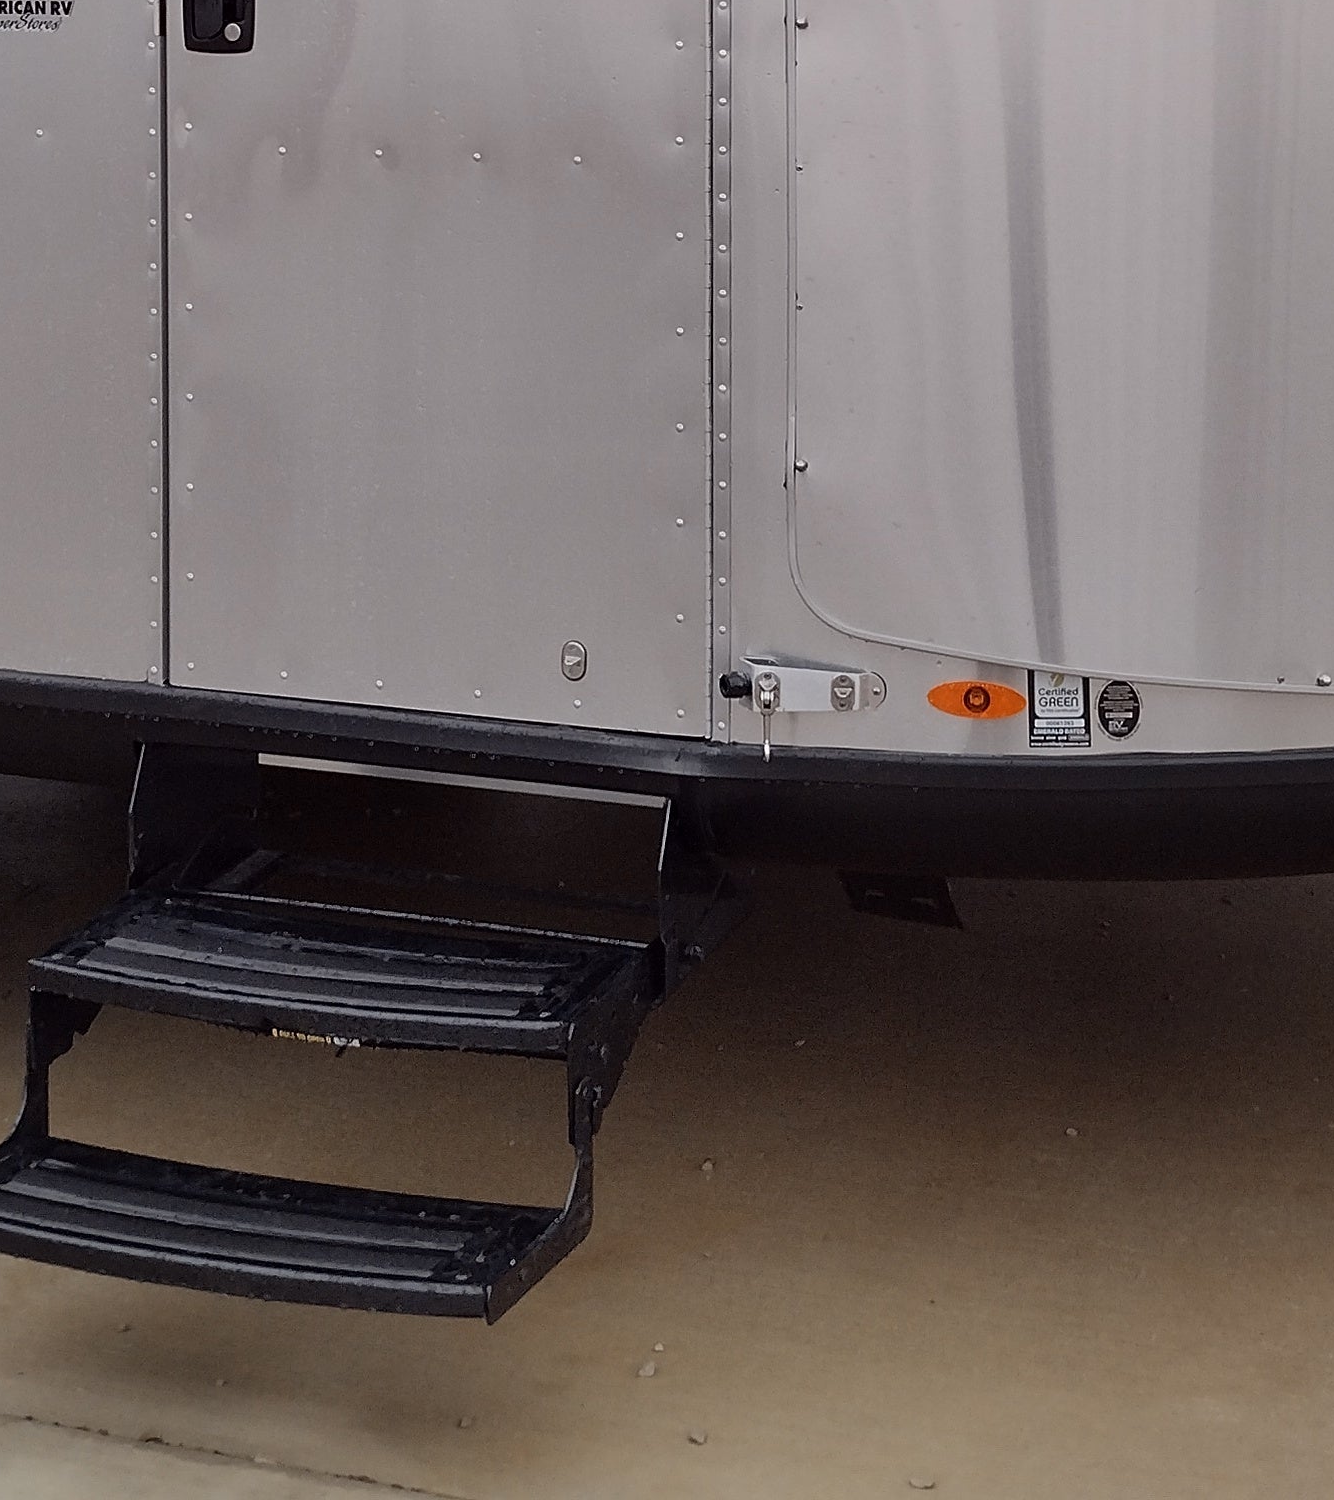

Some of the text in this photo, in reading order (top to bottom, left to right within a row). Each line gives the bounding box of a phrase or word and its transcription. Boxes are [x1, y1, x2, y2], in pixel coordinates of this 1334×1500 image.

[50, 1, 72, 16] RV
[1038, 687, 1079, 696] Certified
[1038, 696, 1079, 707] GREEN
